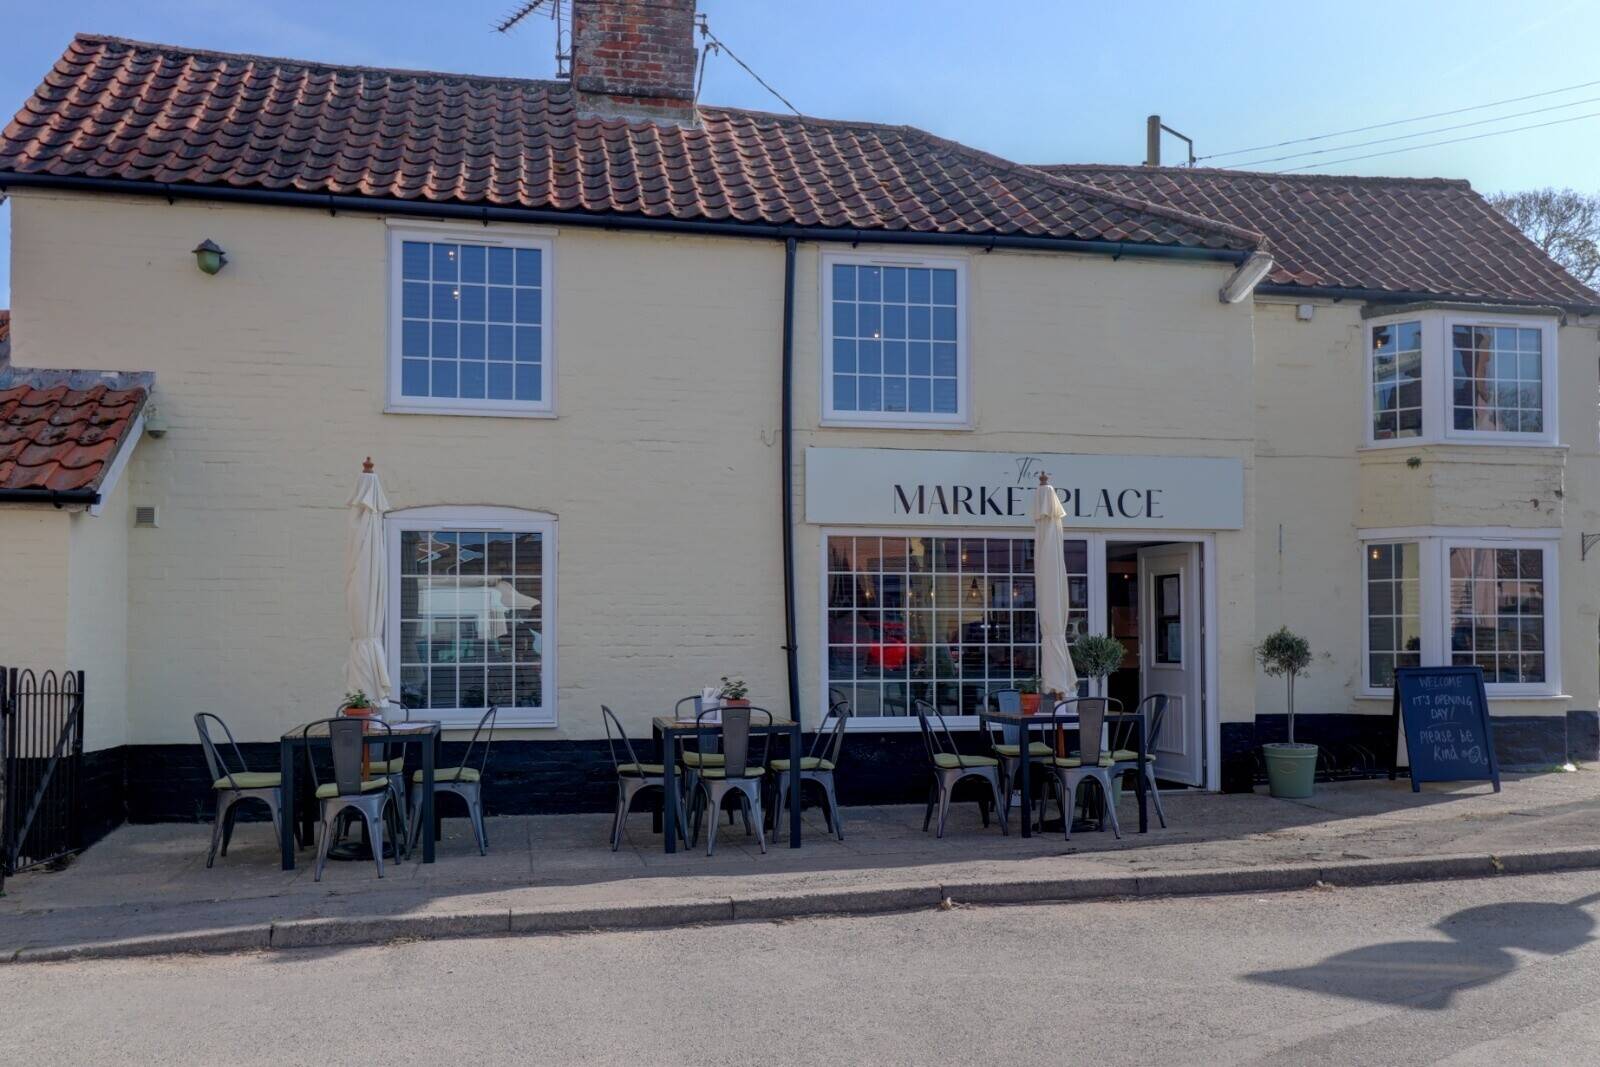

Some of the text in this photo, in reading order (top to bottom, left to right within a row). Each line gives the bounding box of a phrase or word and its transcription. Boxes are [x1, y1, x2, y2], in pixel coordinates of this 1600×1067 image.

[1015, 456, 1043, 484] The
[1419, 676, 1463, 688] WELCOME
[1413, 695, 1473, 714] IT'S OPENING
